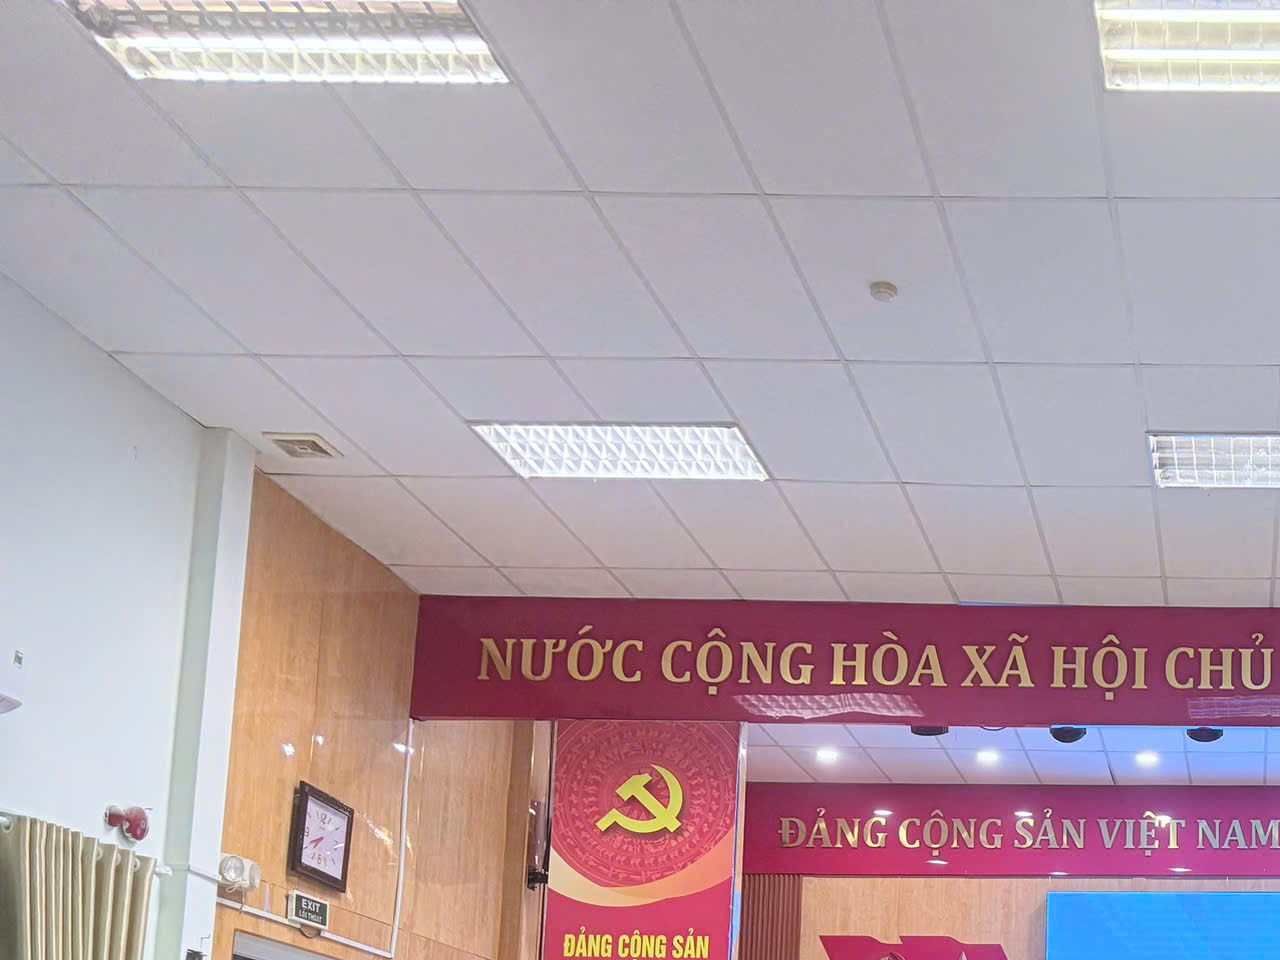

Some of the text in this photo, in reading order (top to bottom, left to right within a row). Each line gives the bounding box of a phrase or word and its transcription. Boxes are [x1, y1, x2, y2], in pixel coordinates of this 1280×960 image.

[477, 625, 643, 682] NƯỚC
[661, 628, 814, 695] CỘNG
[829, 632, 947, 688] HÒA
[960, 634, 1034, 688] XÃ
[1050, 635, 1147, 701] HỘI
[1165, 633, 1273, 690] CHỦ
[778, 808, 888, 849] ĐẢNG
[898, 808, 1003, 856] CỘNG
[1013, 808, 1087, 849] SẢN
[1097, 810, 1186, 856] VIỆT
[1196, 819, 1280, 849] NAM
[301, 898, 321, 913] EXIT
[563, 927, 612, 958] ĐẢNG
[672, 928, 709, 959] SẢN
